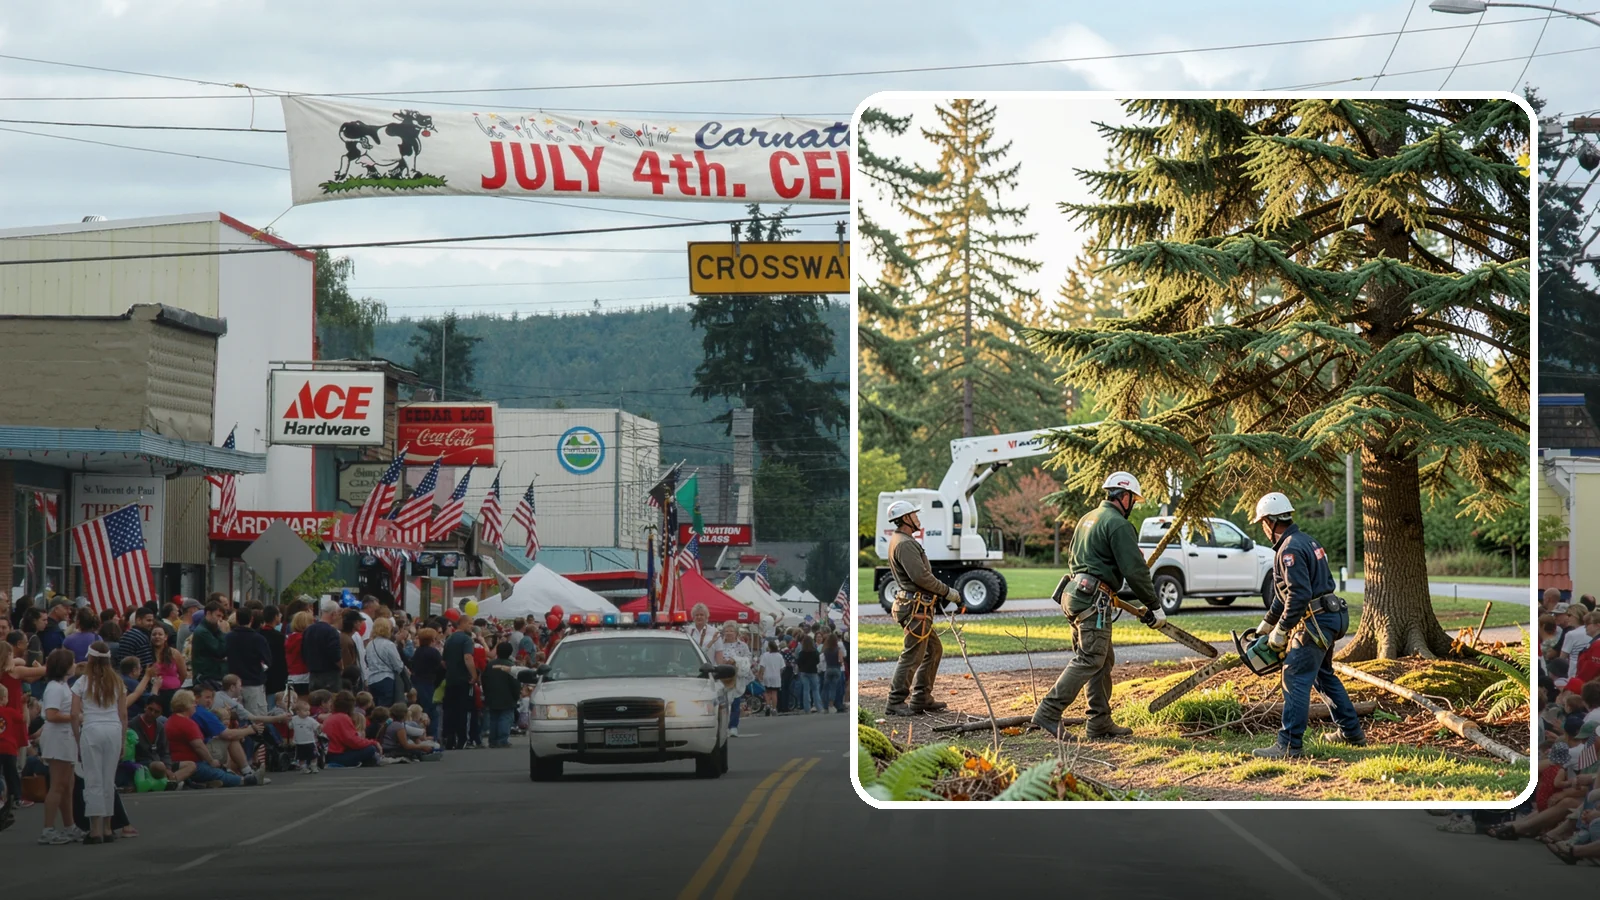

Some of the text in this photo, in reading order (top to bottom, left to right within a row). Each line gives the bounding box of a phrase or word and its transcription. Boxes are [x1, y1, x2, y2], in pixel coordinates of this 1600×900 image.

[480, 140, 605, 193] JULY
[632, 149, 747, 199] 4th.
[696, 254, 850, 280] CROSSWA
[282, 380, 374, 420] ACE
[405, 409, 453, 422] CEDAR
[283, 420, 371, 436] Hardware
[416, 427, 477, 447] Coca-Cola
[96, 485, 124, 494] Vincent
[126, 485, 136, 494] de
[138, 486, 155, 495] Paul
[212, 516, 331, 535] HARDARE
[688, 526, 742, 535] CRNATION
[699, 535, 730, 543] GLASS
